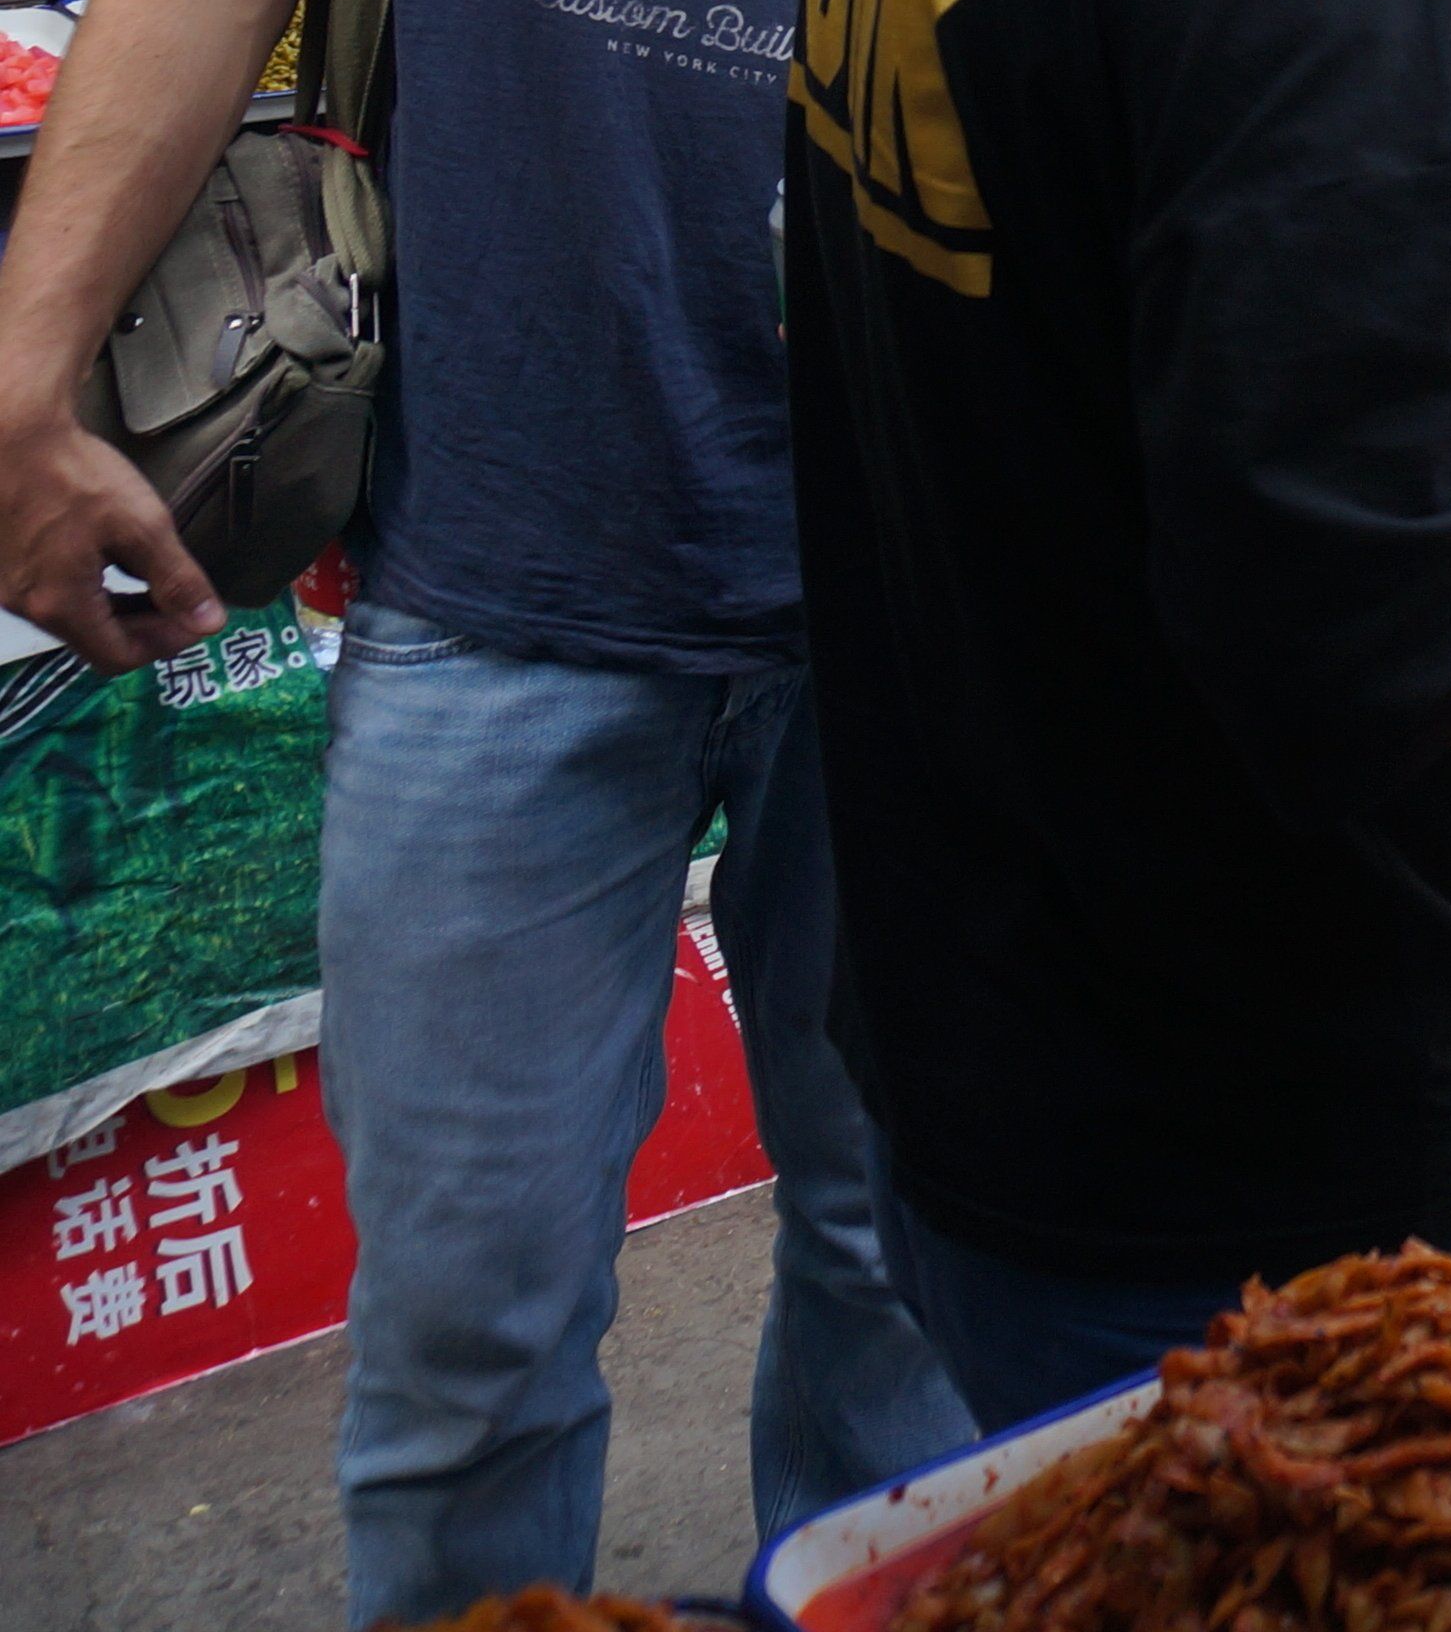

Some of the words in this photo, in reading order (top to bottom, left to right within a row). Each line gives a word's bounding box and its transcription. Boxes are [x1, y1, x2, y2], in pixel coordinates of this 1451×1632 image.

[606, 38, 651, 59] NEW
[663, 50, 718, 75] YORK
[728, 65, 779, 87] CITY
[144, 1132, 254, 1317] 折后
